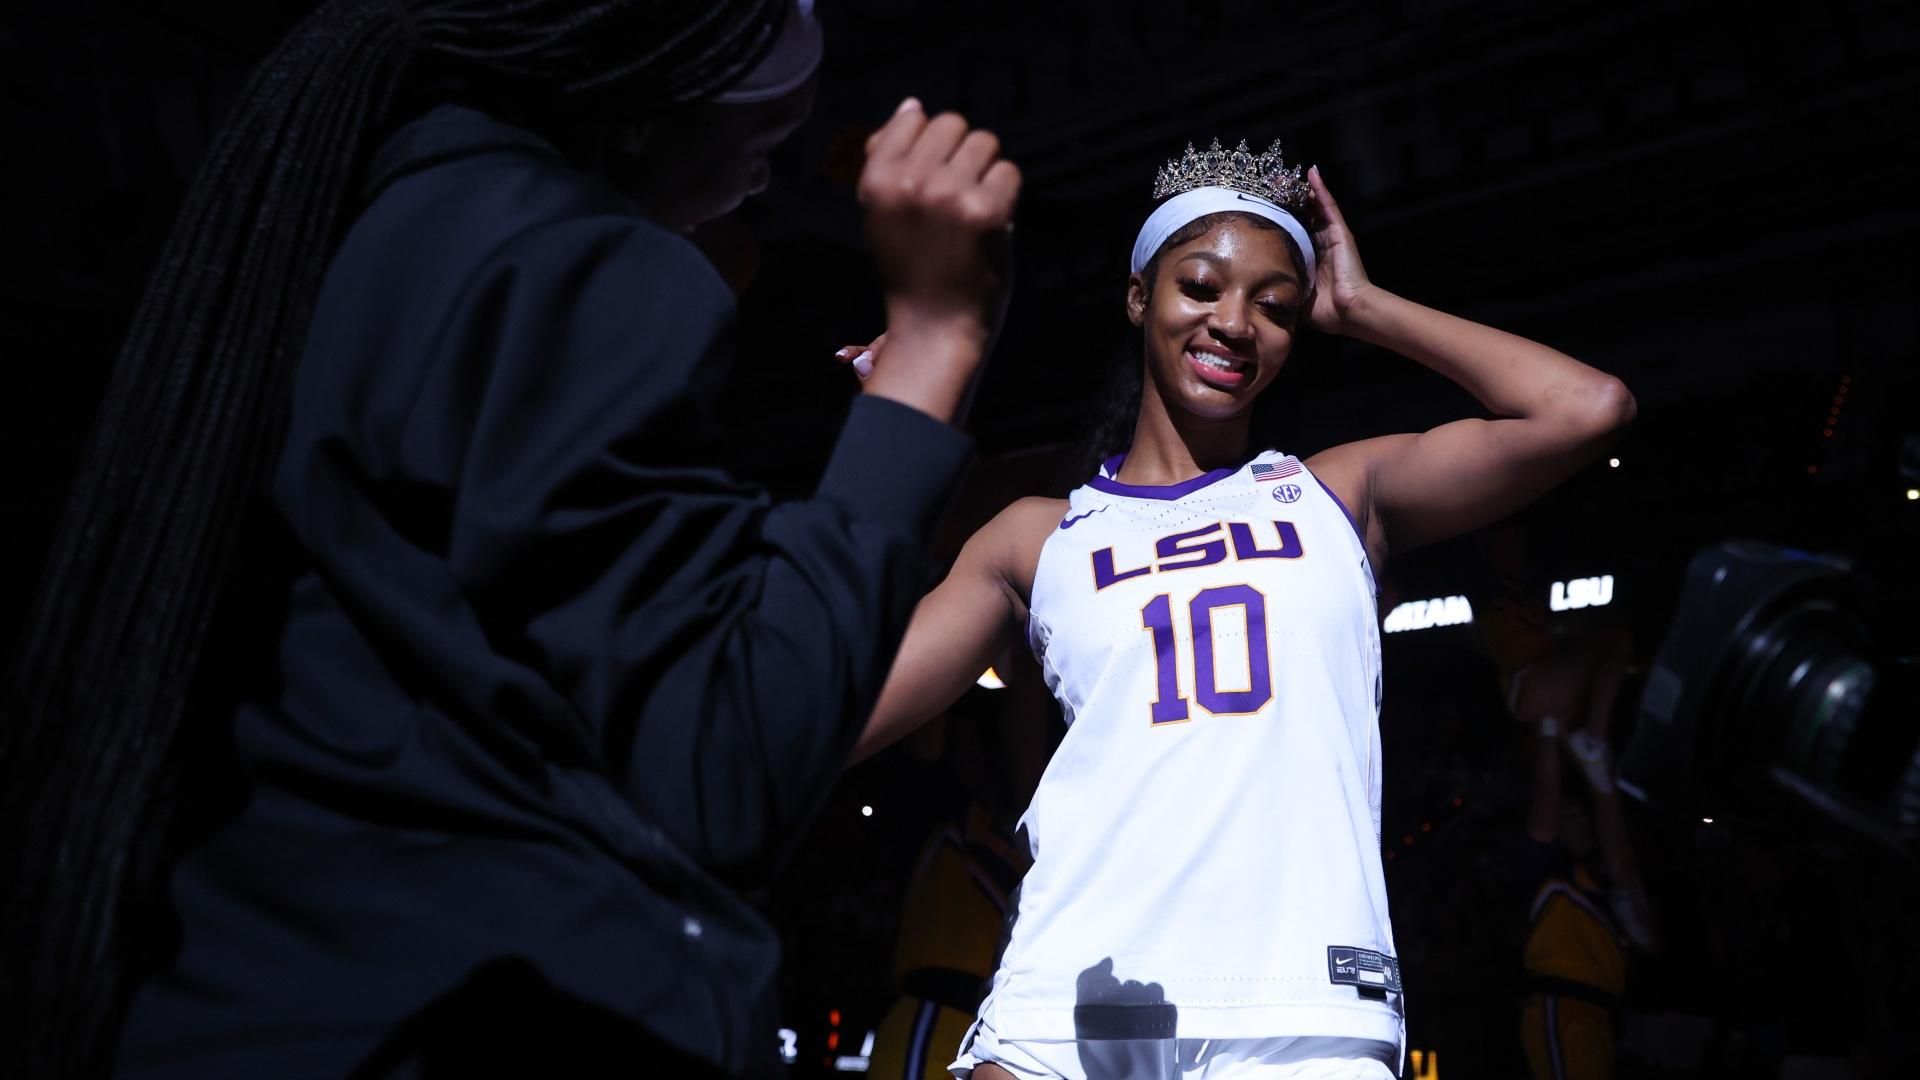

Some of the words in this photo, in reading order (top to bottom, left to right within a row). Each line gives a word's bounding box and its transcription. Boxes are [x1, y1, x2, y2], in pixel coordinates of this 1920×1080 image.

[1273, 485, 1301, 502] SEC
[1091, 520, 1305, 592] LSU
[1550, 574, 1614, 611] LSU
[1140, 583, 1275, 727] 10
